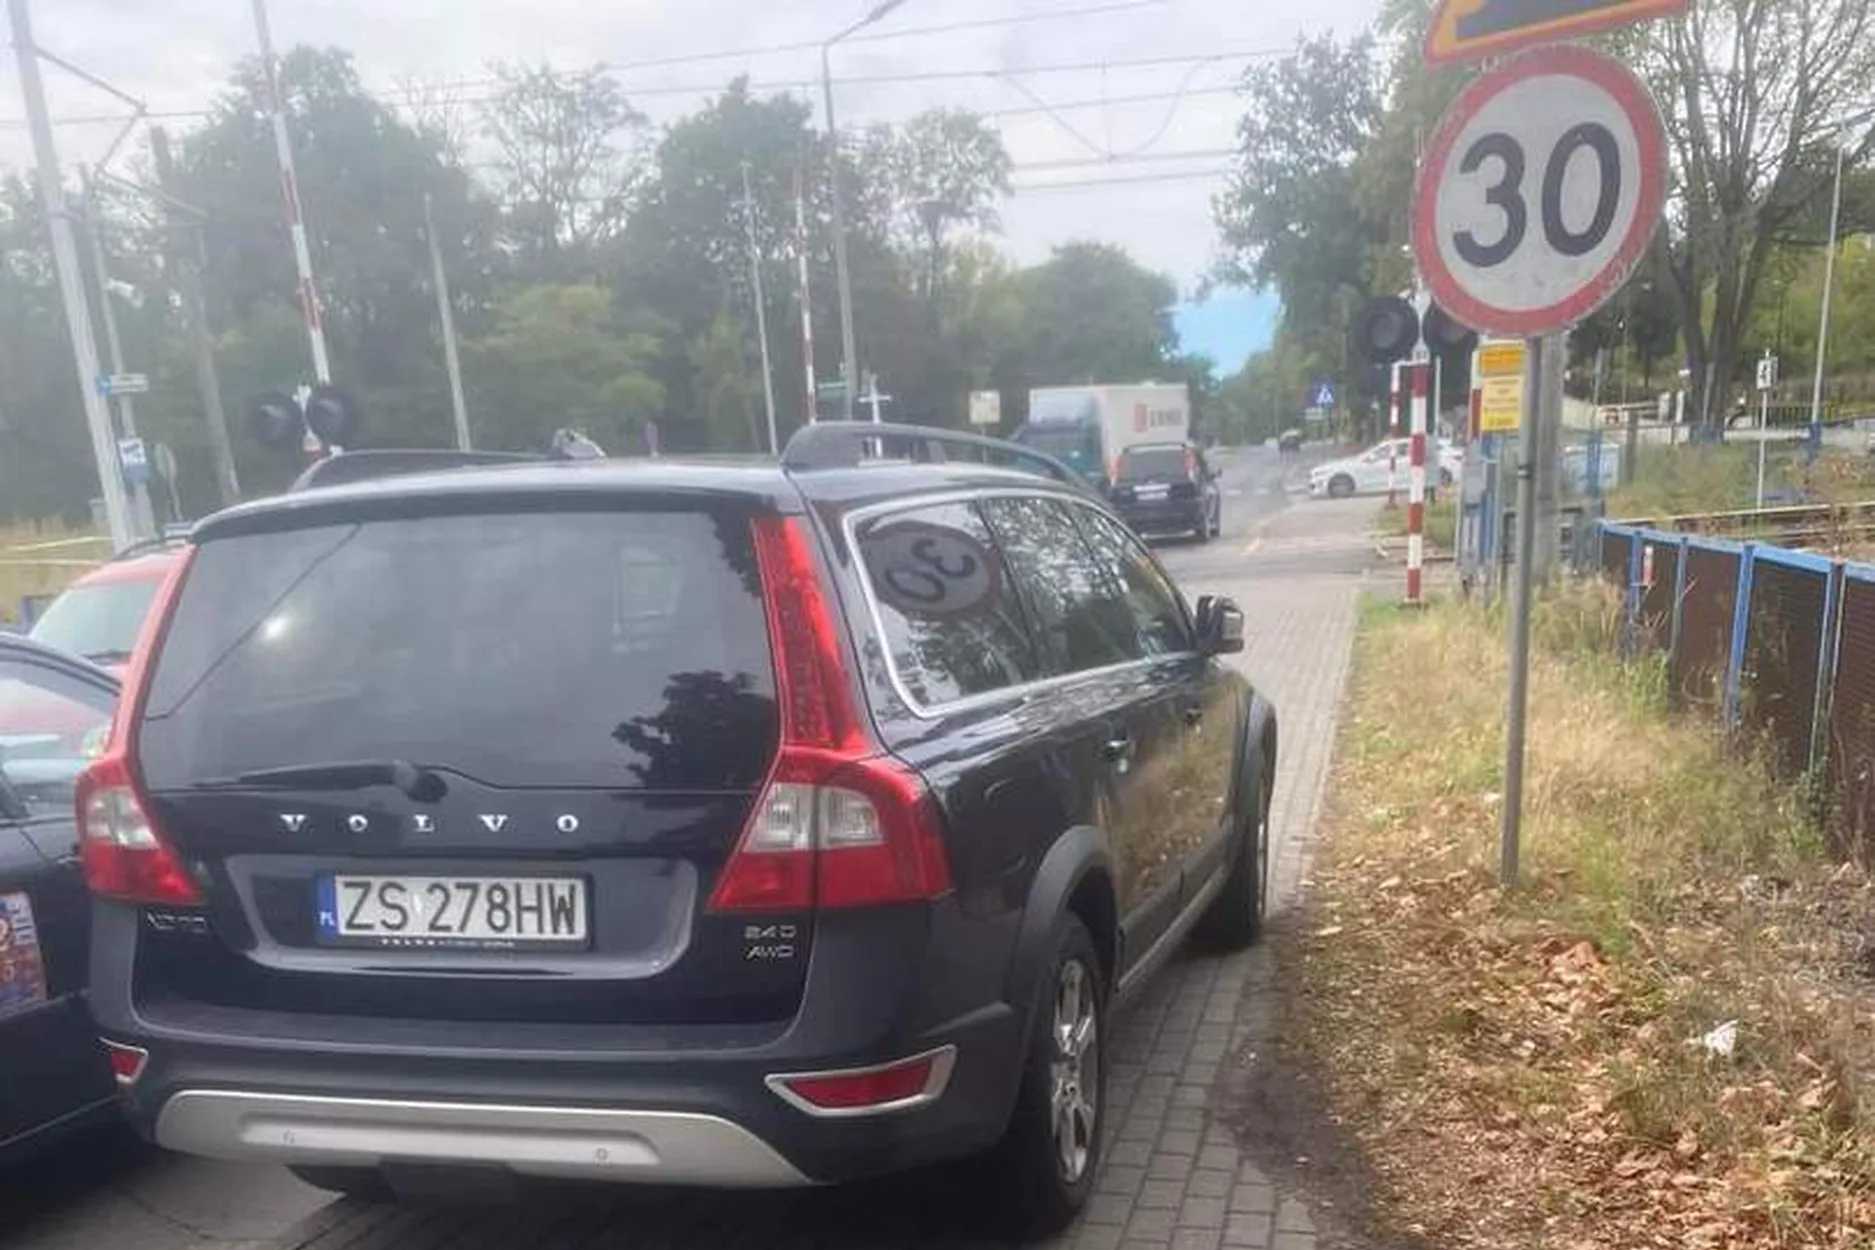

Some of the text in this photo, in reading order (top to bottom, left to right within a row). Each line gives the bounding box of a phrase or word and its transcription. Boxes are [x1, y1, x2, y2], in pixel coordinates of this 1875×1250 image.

[1453, 121, 1621, 267] 30
[280, 814, 579, 832] VOLVO
[343, 881, 577, 934] ZS 278HW
